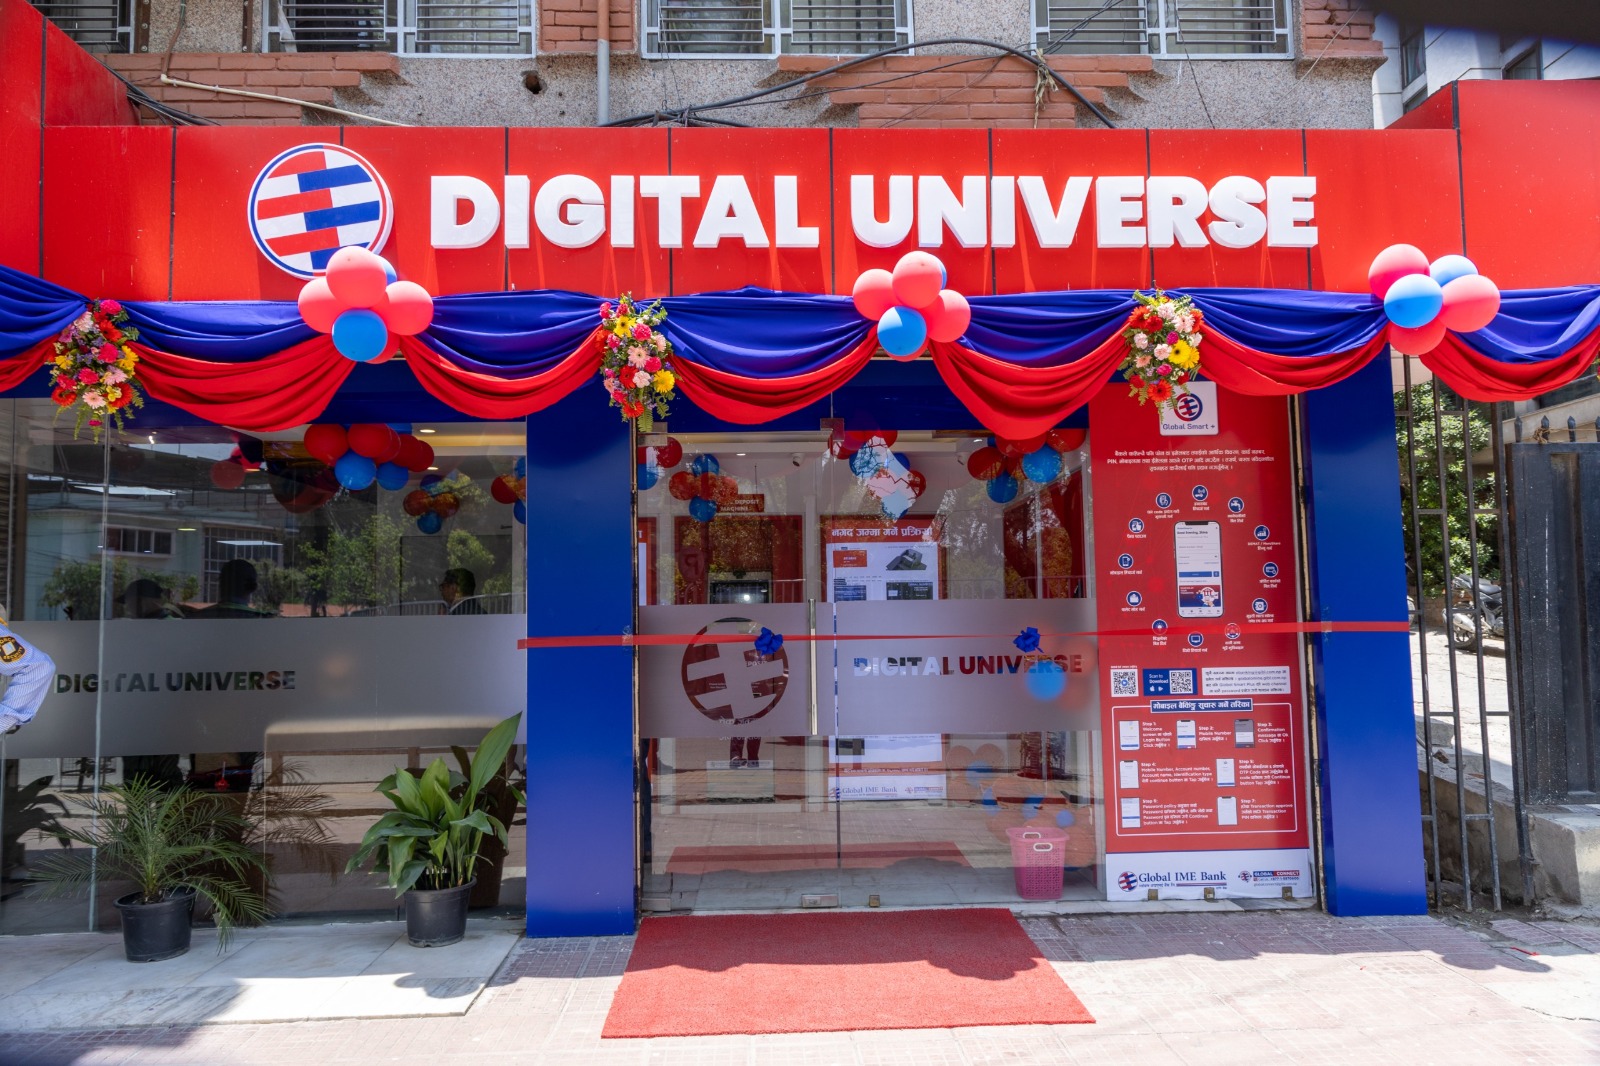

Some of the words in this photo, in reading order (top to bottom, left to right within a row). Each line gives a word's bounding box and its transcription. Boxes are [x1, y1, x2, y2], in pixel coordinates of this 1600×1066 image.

[430, 174, 819, 249] DIGITAL
[851, 174, 1318, 248] UNIVERSE
[832, 528, 854, 537] नगद
[856, 528, 880, 537] जम्मा
[853, 656, 954, 677] DIGITAL
[959, 654, 1082, 675] UNIVERSE
[54, 673, 159, 694] DIGITAL
[166, 671, 295, 692] UNIVERSE
[1139, 872, 1171, 882] Global
[1175, 872, 1196, 881] IME
[1201, 871, 1226, 881] Bank
